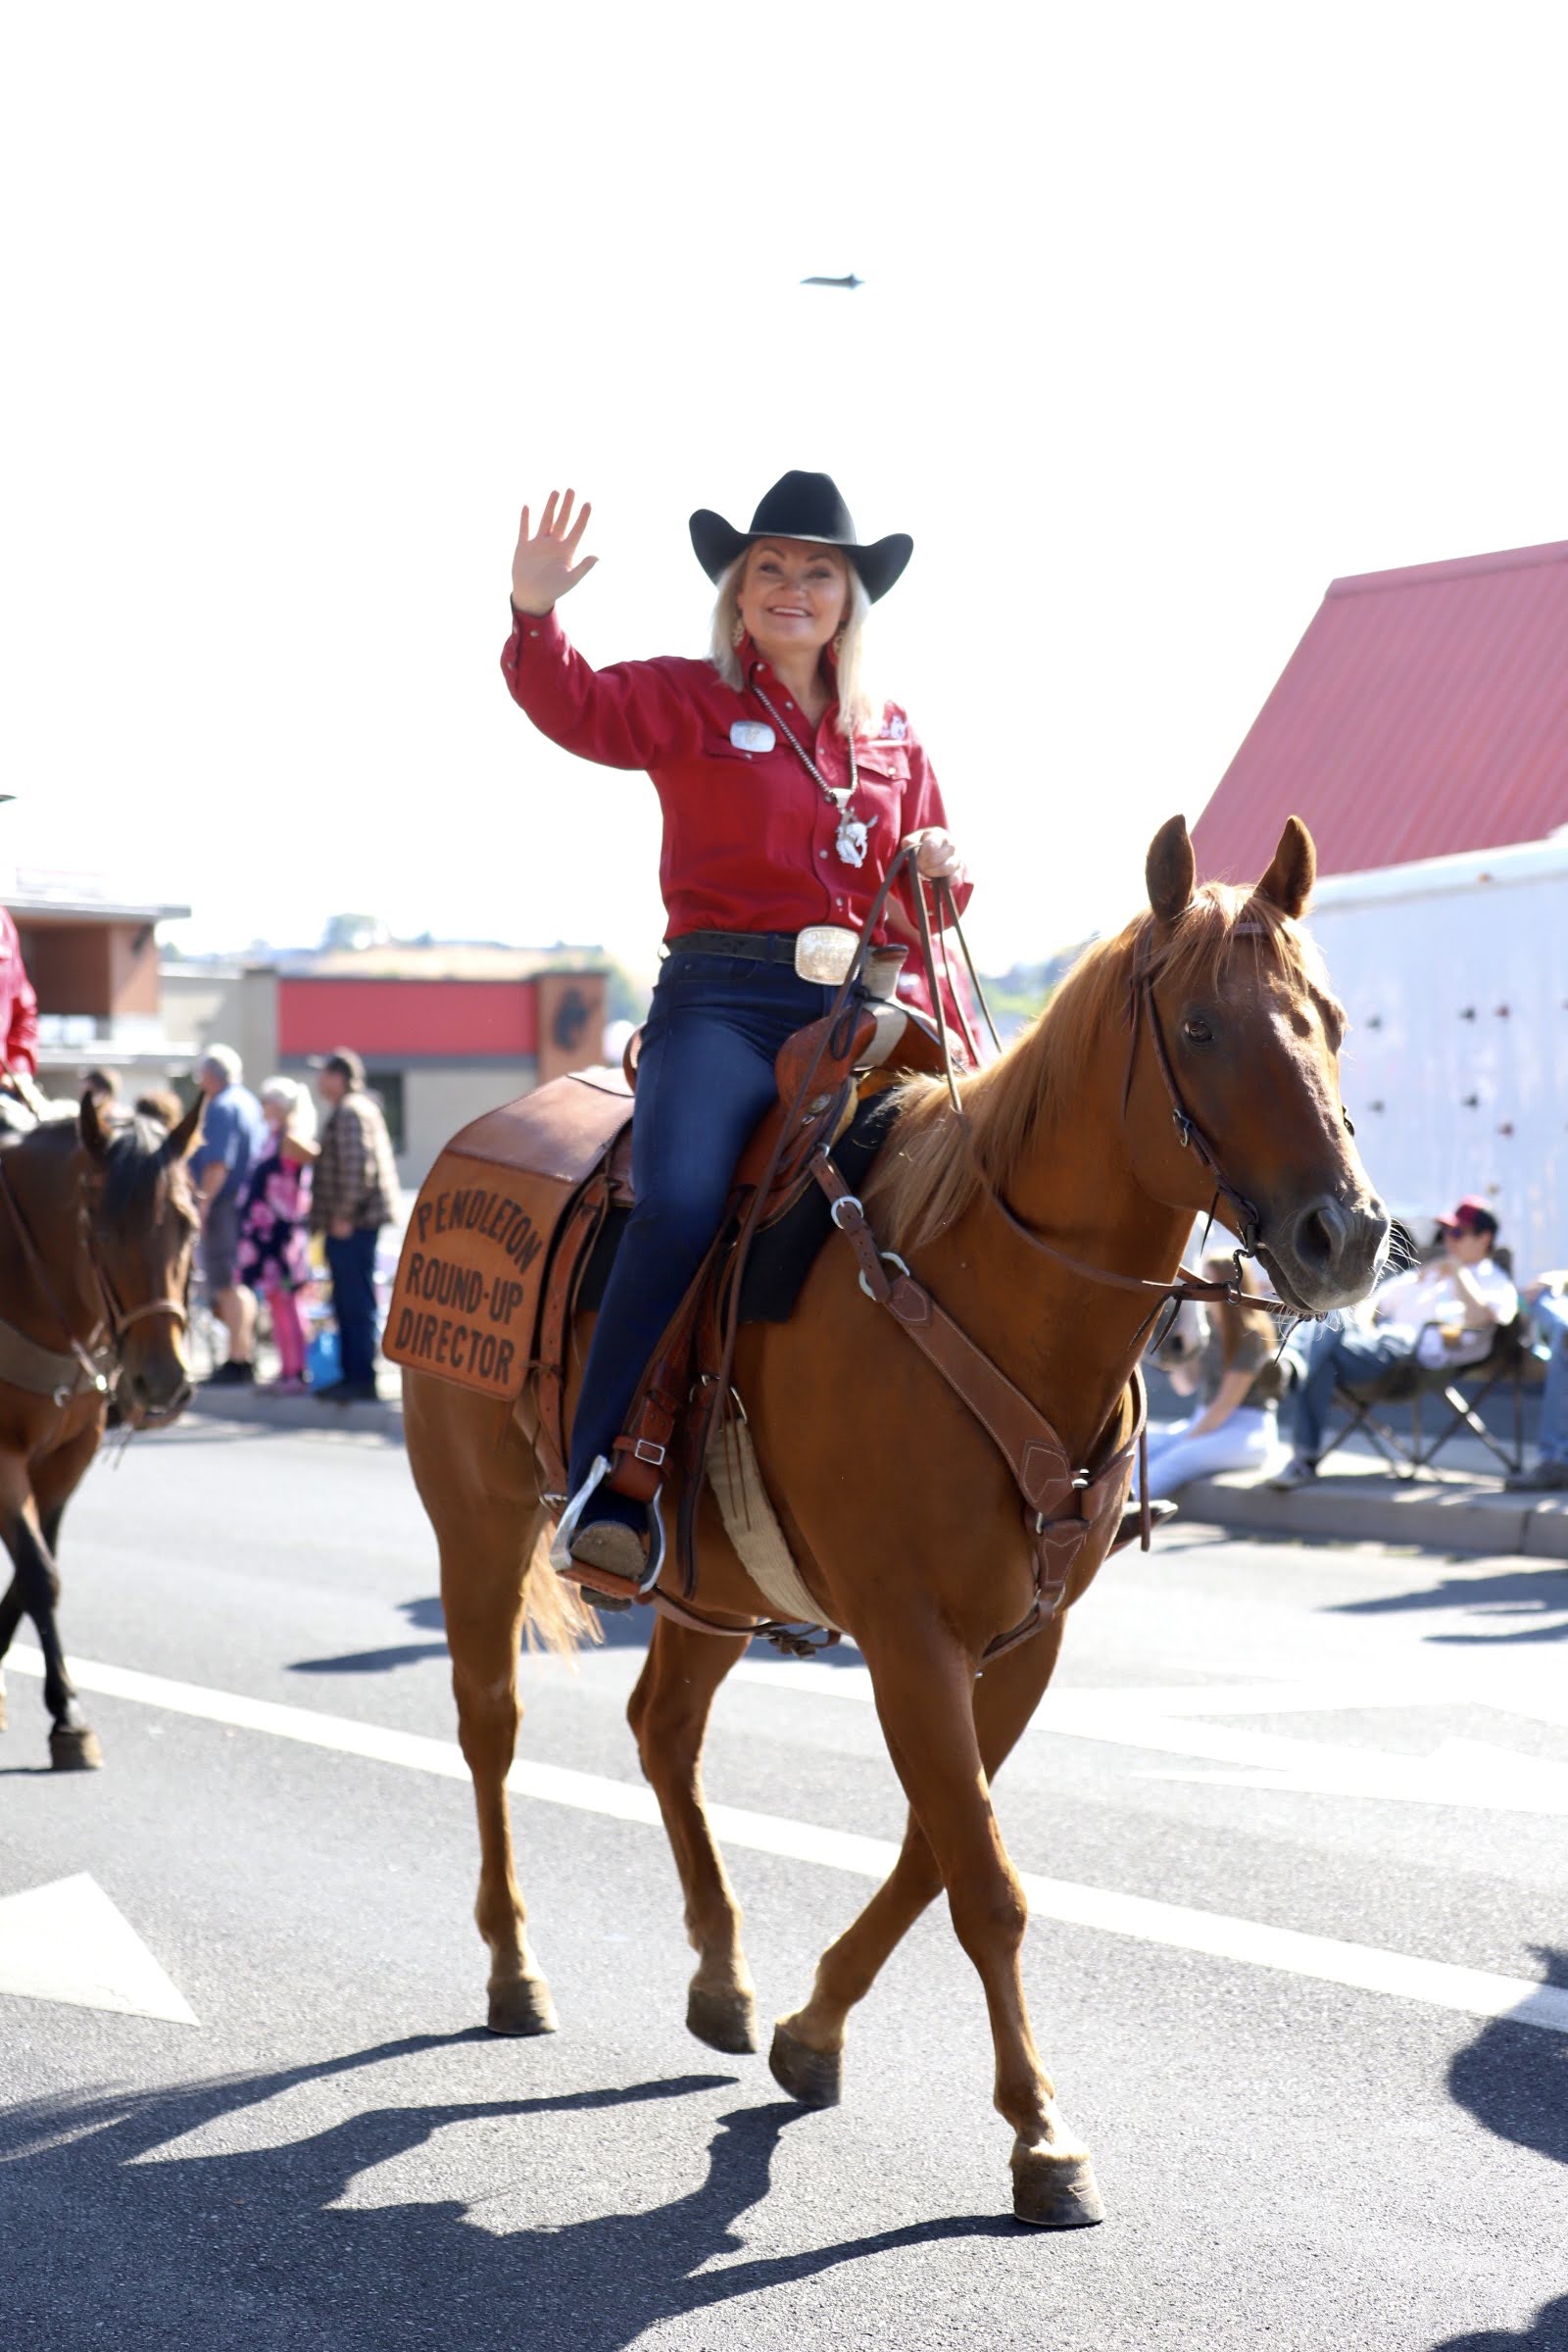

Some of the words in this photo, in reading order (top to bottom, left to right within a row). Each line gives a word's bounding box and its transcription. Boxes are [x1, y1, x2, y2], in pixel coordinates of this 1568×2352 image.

[417, 1190, 542, 1272] PENDLETON
[406, 1252, 523, 1325] ROUND-UP
[394, 1308, 514, 1384] DIRECTOR
